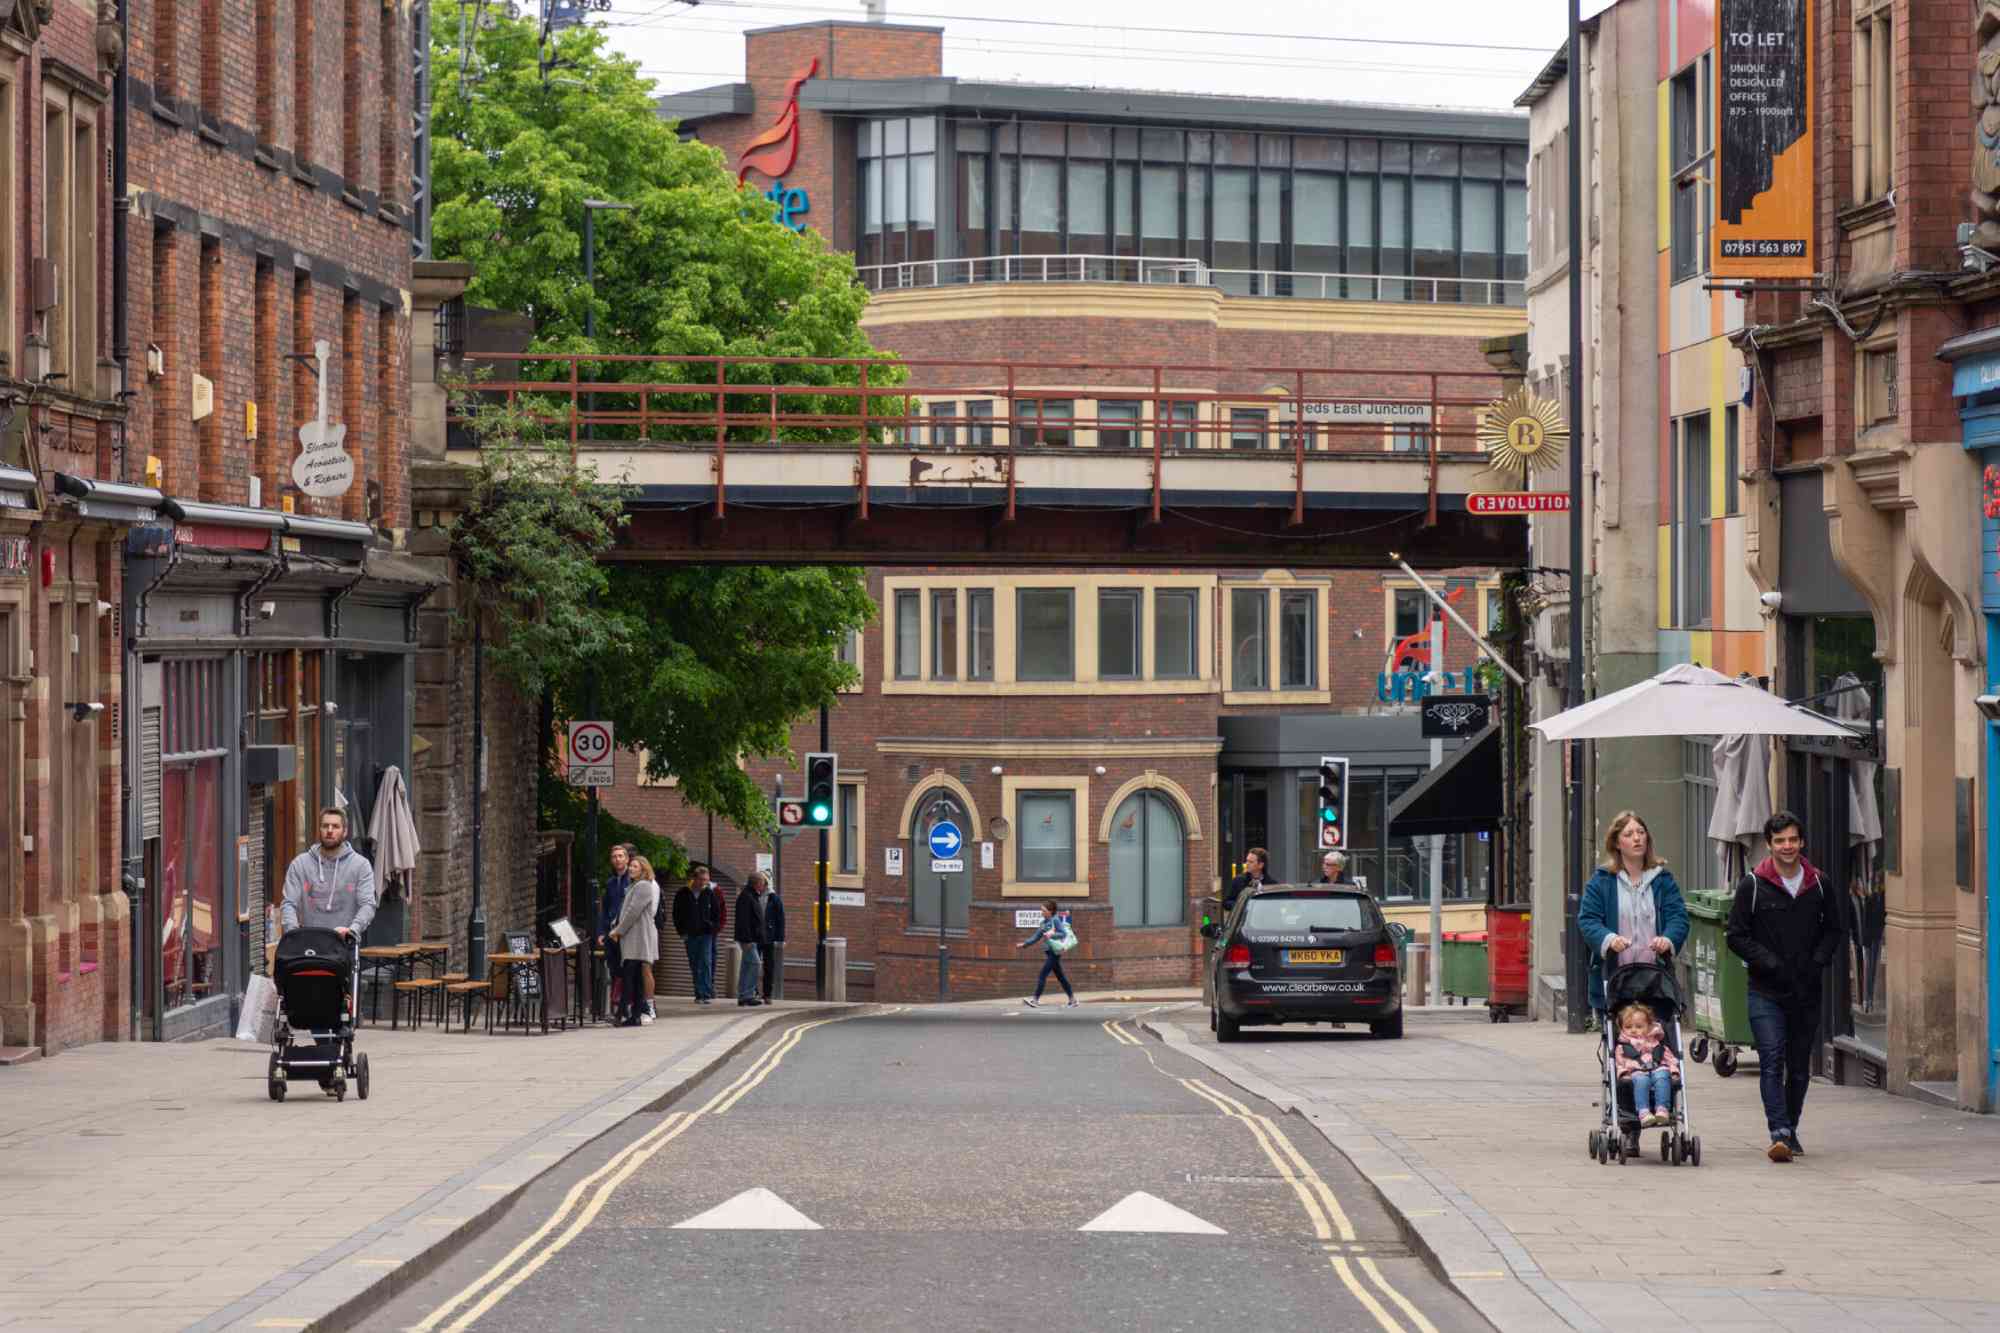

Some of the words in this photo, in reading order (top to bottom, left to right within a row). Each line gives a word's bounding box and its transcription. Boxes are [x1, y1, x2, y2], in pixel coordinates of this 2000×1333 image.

[1730, 32, 1752, 47] TO
[1758, 32, 1785, 46] LET
[1730, 64, 1766, 73] UNIQUE
[1730, 79, 1763, 88] DESIGN
[1730, 92, 1767, 101] OFFICES
[1730, 107, 1746, 115] 875
[1725, 243, 1755, 253] 07951
[1760, 243, 1779, 253] 563
[1783, 243, 1801, 253] 897
[1289, 402, 1329, 414] Leds
[1333, 403, 1362, 414] East
[1366, 404, 1424, 414] Junction
[1515, 423, 1535, 446] R
[578, 735, 606, 751] 30
[588, 776, 611, 784] ENDS
[1262, 983, 1365, 992] www.clearbrew.co.uk
